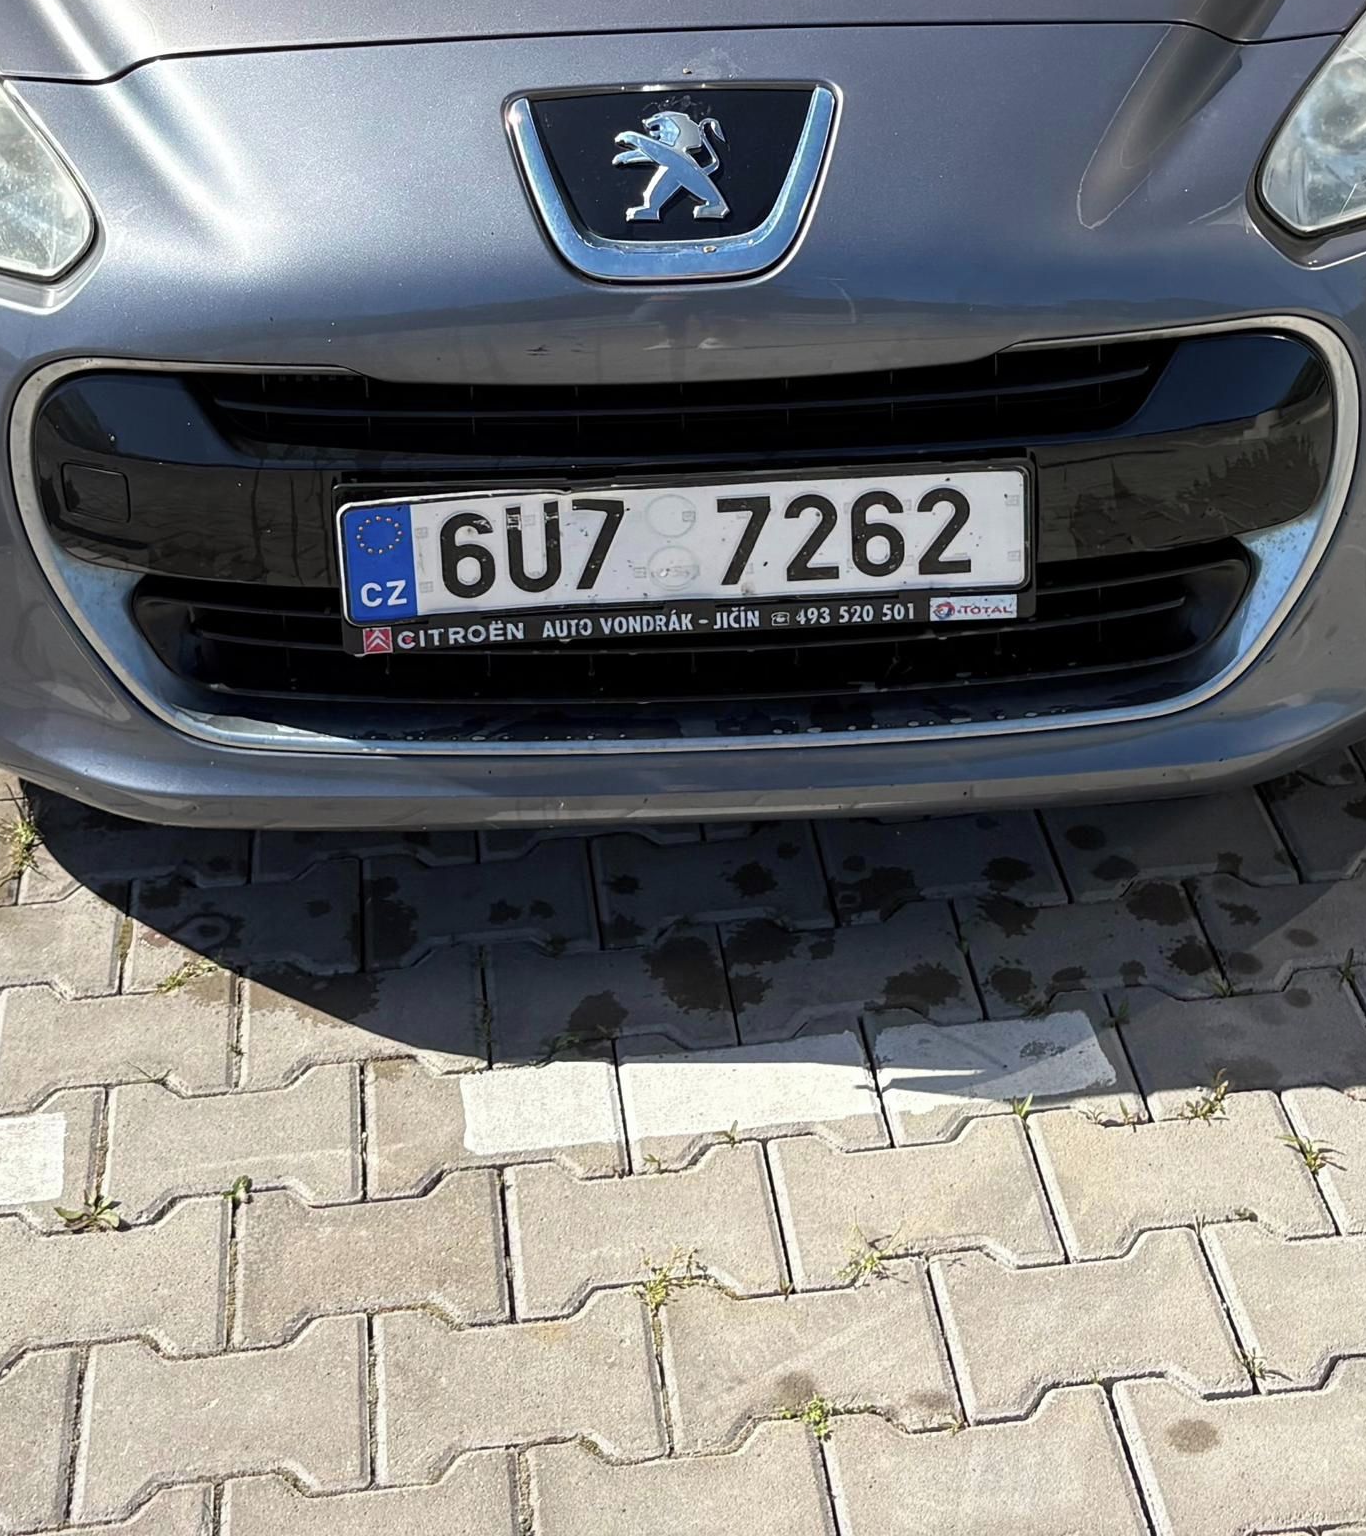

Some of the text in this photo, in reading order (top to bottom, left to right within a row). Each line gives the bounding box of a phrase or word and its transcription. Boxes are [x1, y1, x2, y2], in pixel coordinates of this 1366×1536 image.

[439, 486, 972, 599] 6U7 7262
[360, 579, 408, 608] CZ
[542, 618, 593, 638] AUTO
[600, 609, 694, 635] VONDRÁK
[713, 607, 761, 630] JIČÍN
[795, 607, 832, 625] 493
[838, 605, 874, 624] 520
[881, 603, 916, 621] 501
[962, 605, 1014, 615] TOTAL
[397, 620, 525, 650] CITROËN
